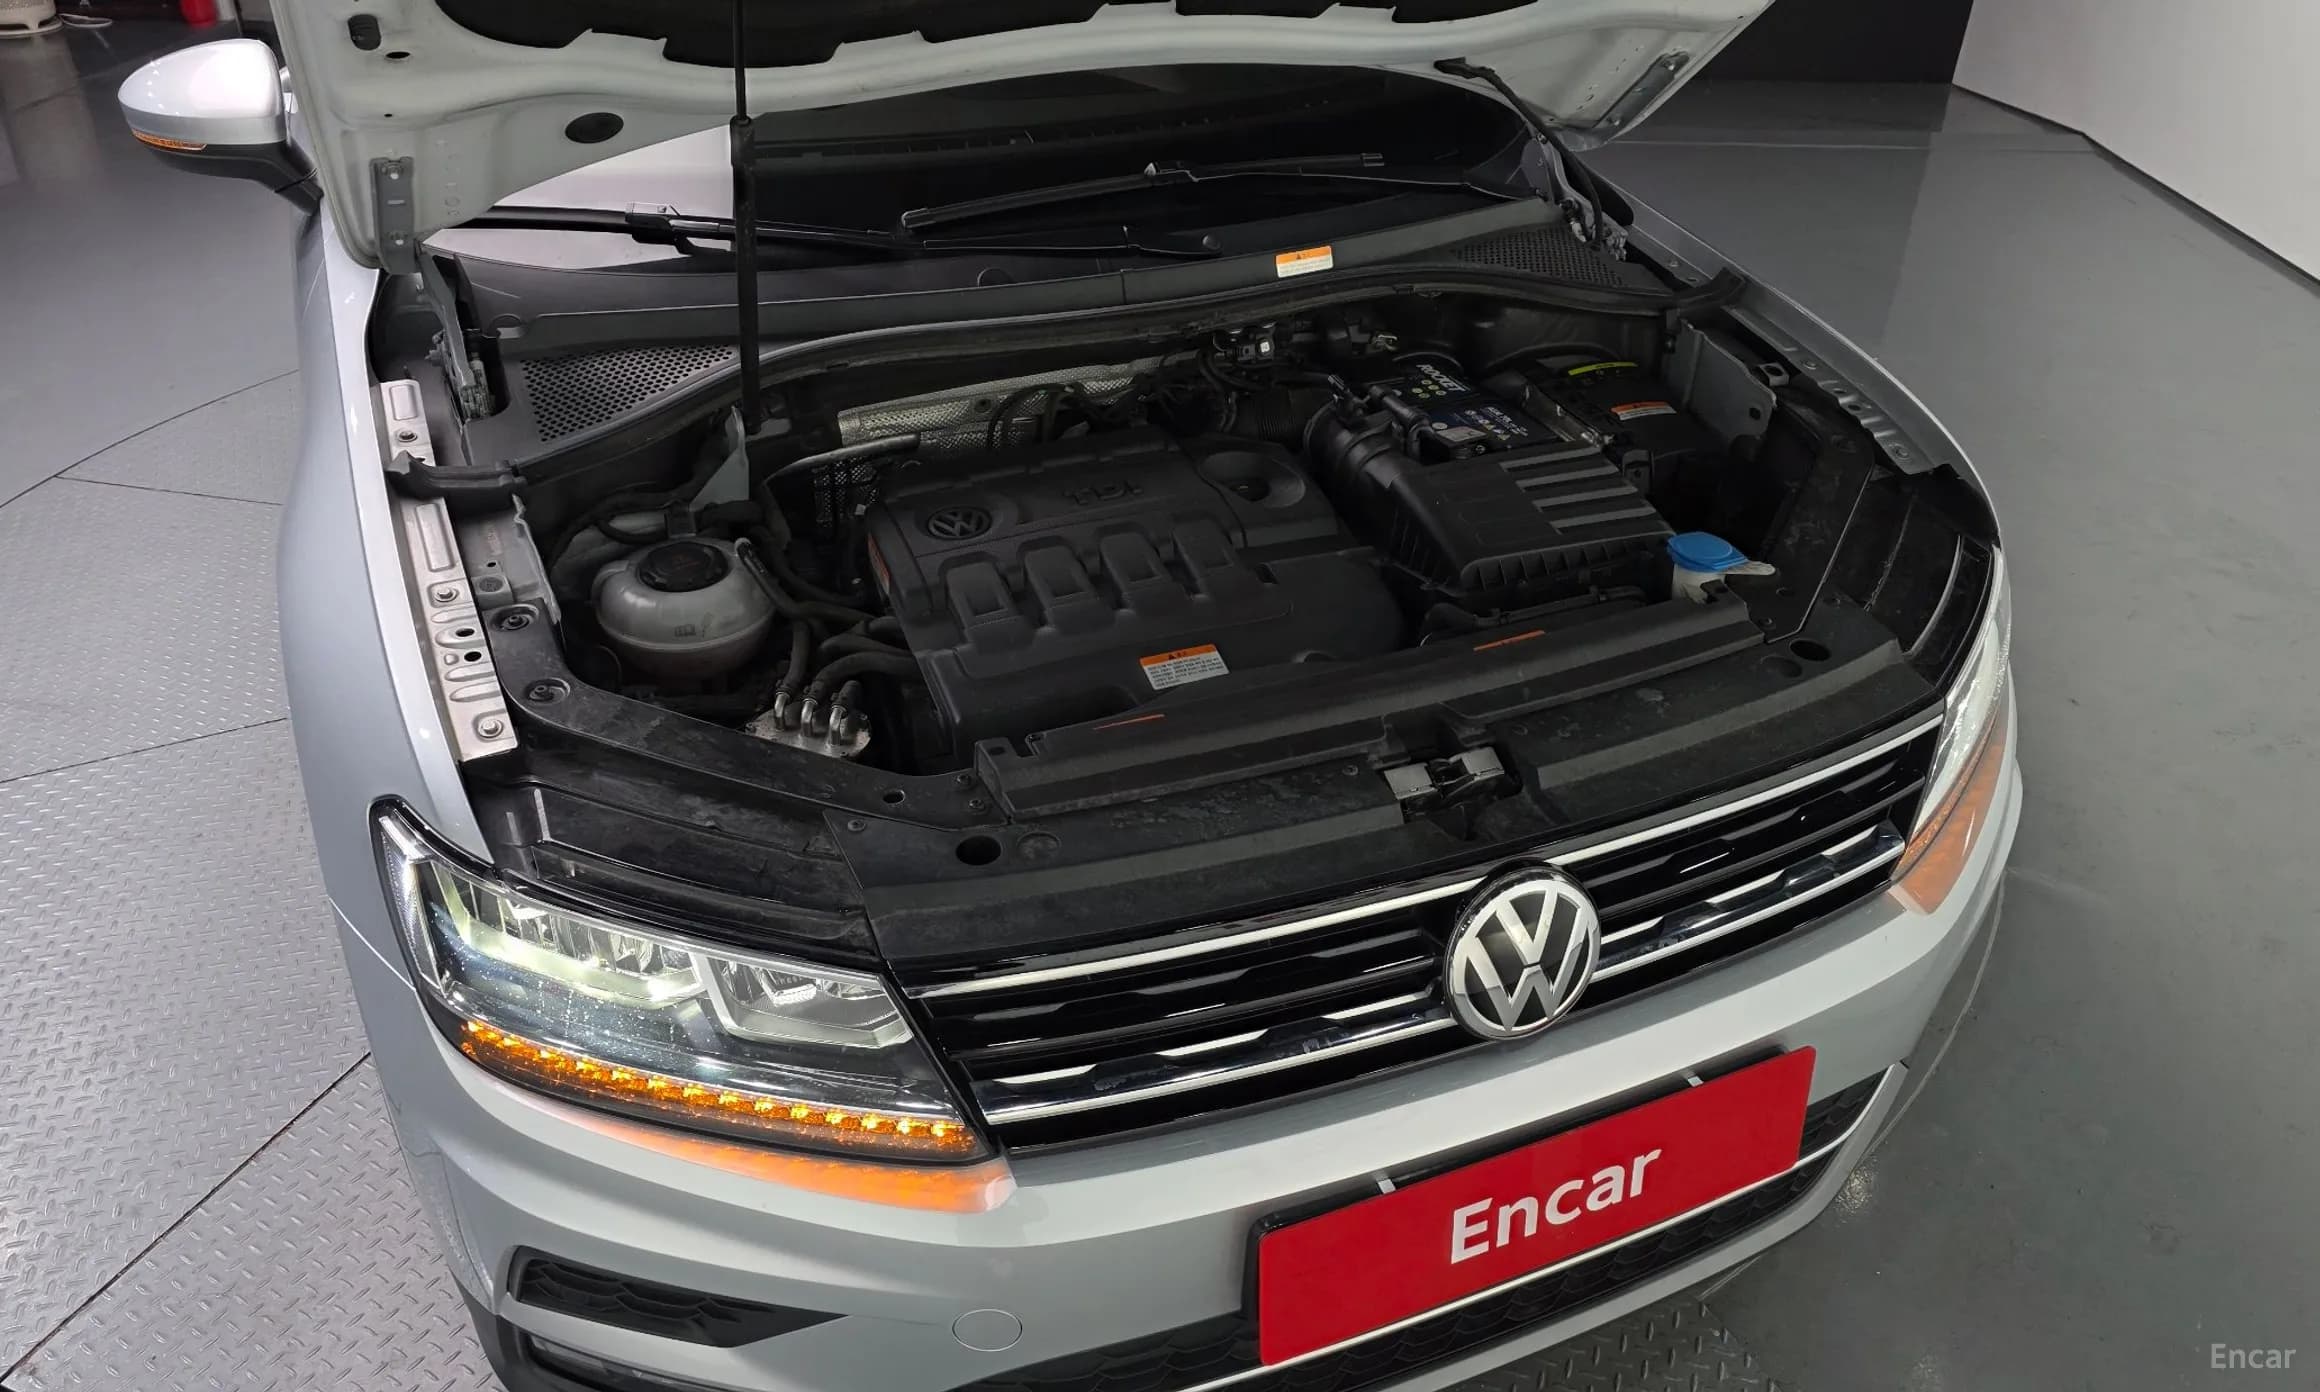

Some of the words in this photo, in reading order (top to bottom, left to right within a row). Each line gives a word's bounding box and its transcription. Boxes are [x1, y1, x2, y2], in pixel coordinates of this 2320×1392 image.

[1416, 364, 1466, 392] ROCKET
[1451, 877, 1600, 1038] VW
[1450, 1148, 1662, 1265] Encar
